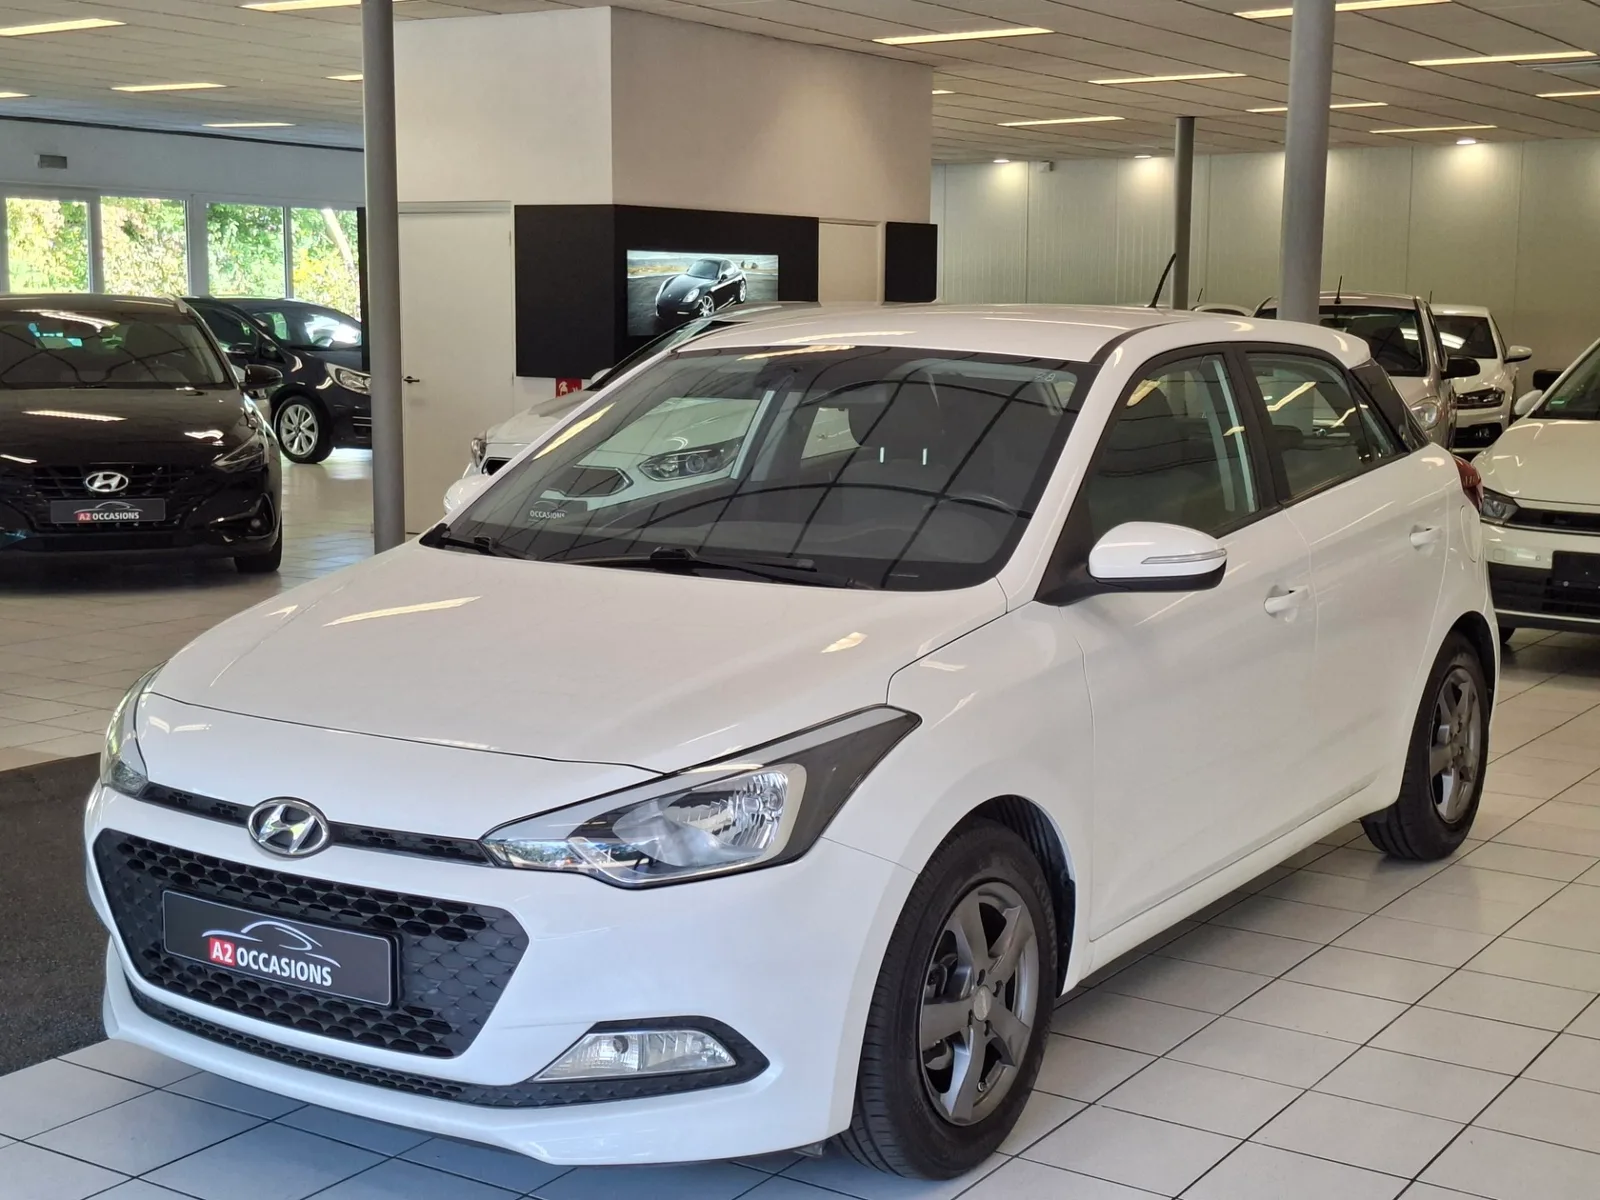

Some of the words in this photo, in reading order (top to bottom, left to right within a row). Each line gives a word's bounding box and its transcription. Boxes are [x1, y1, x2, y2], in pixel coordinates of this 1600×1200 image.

[78, 512, 92, 521] A2
[92, 511, 140, 521] OCCASIONS
[212, 941, 233, 964] A2
[236, 946, 332, 987] OCCASIONS
